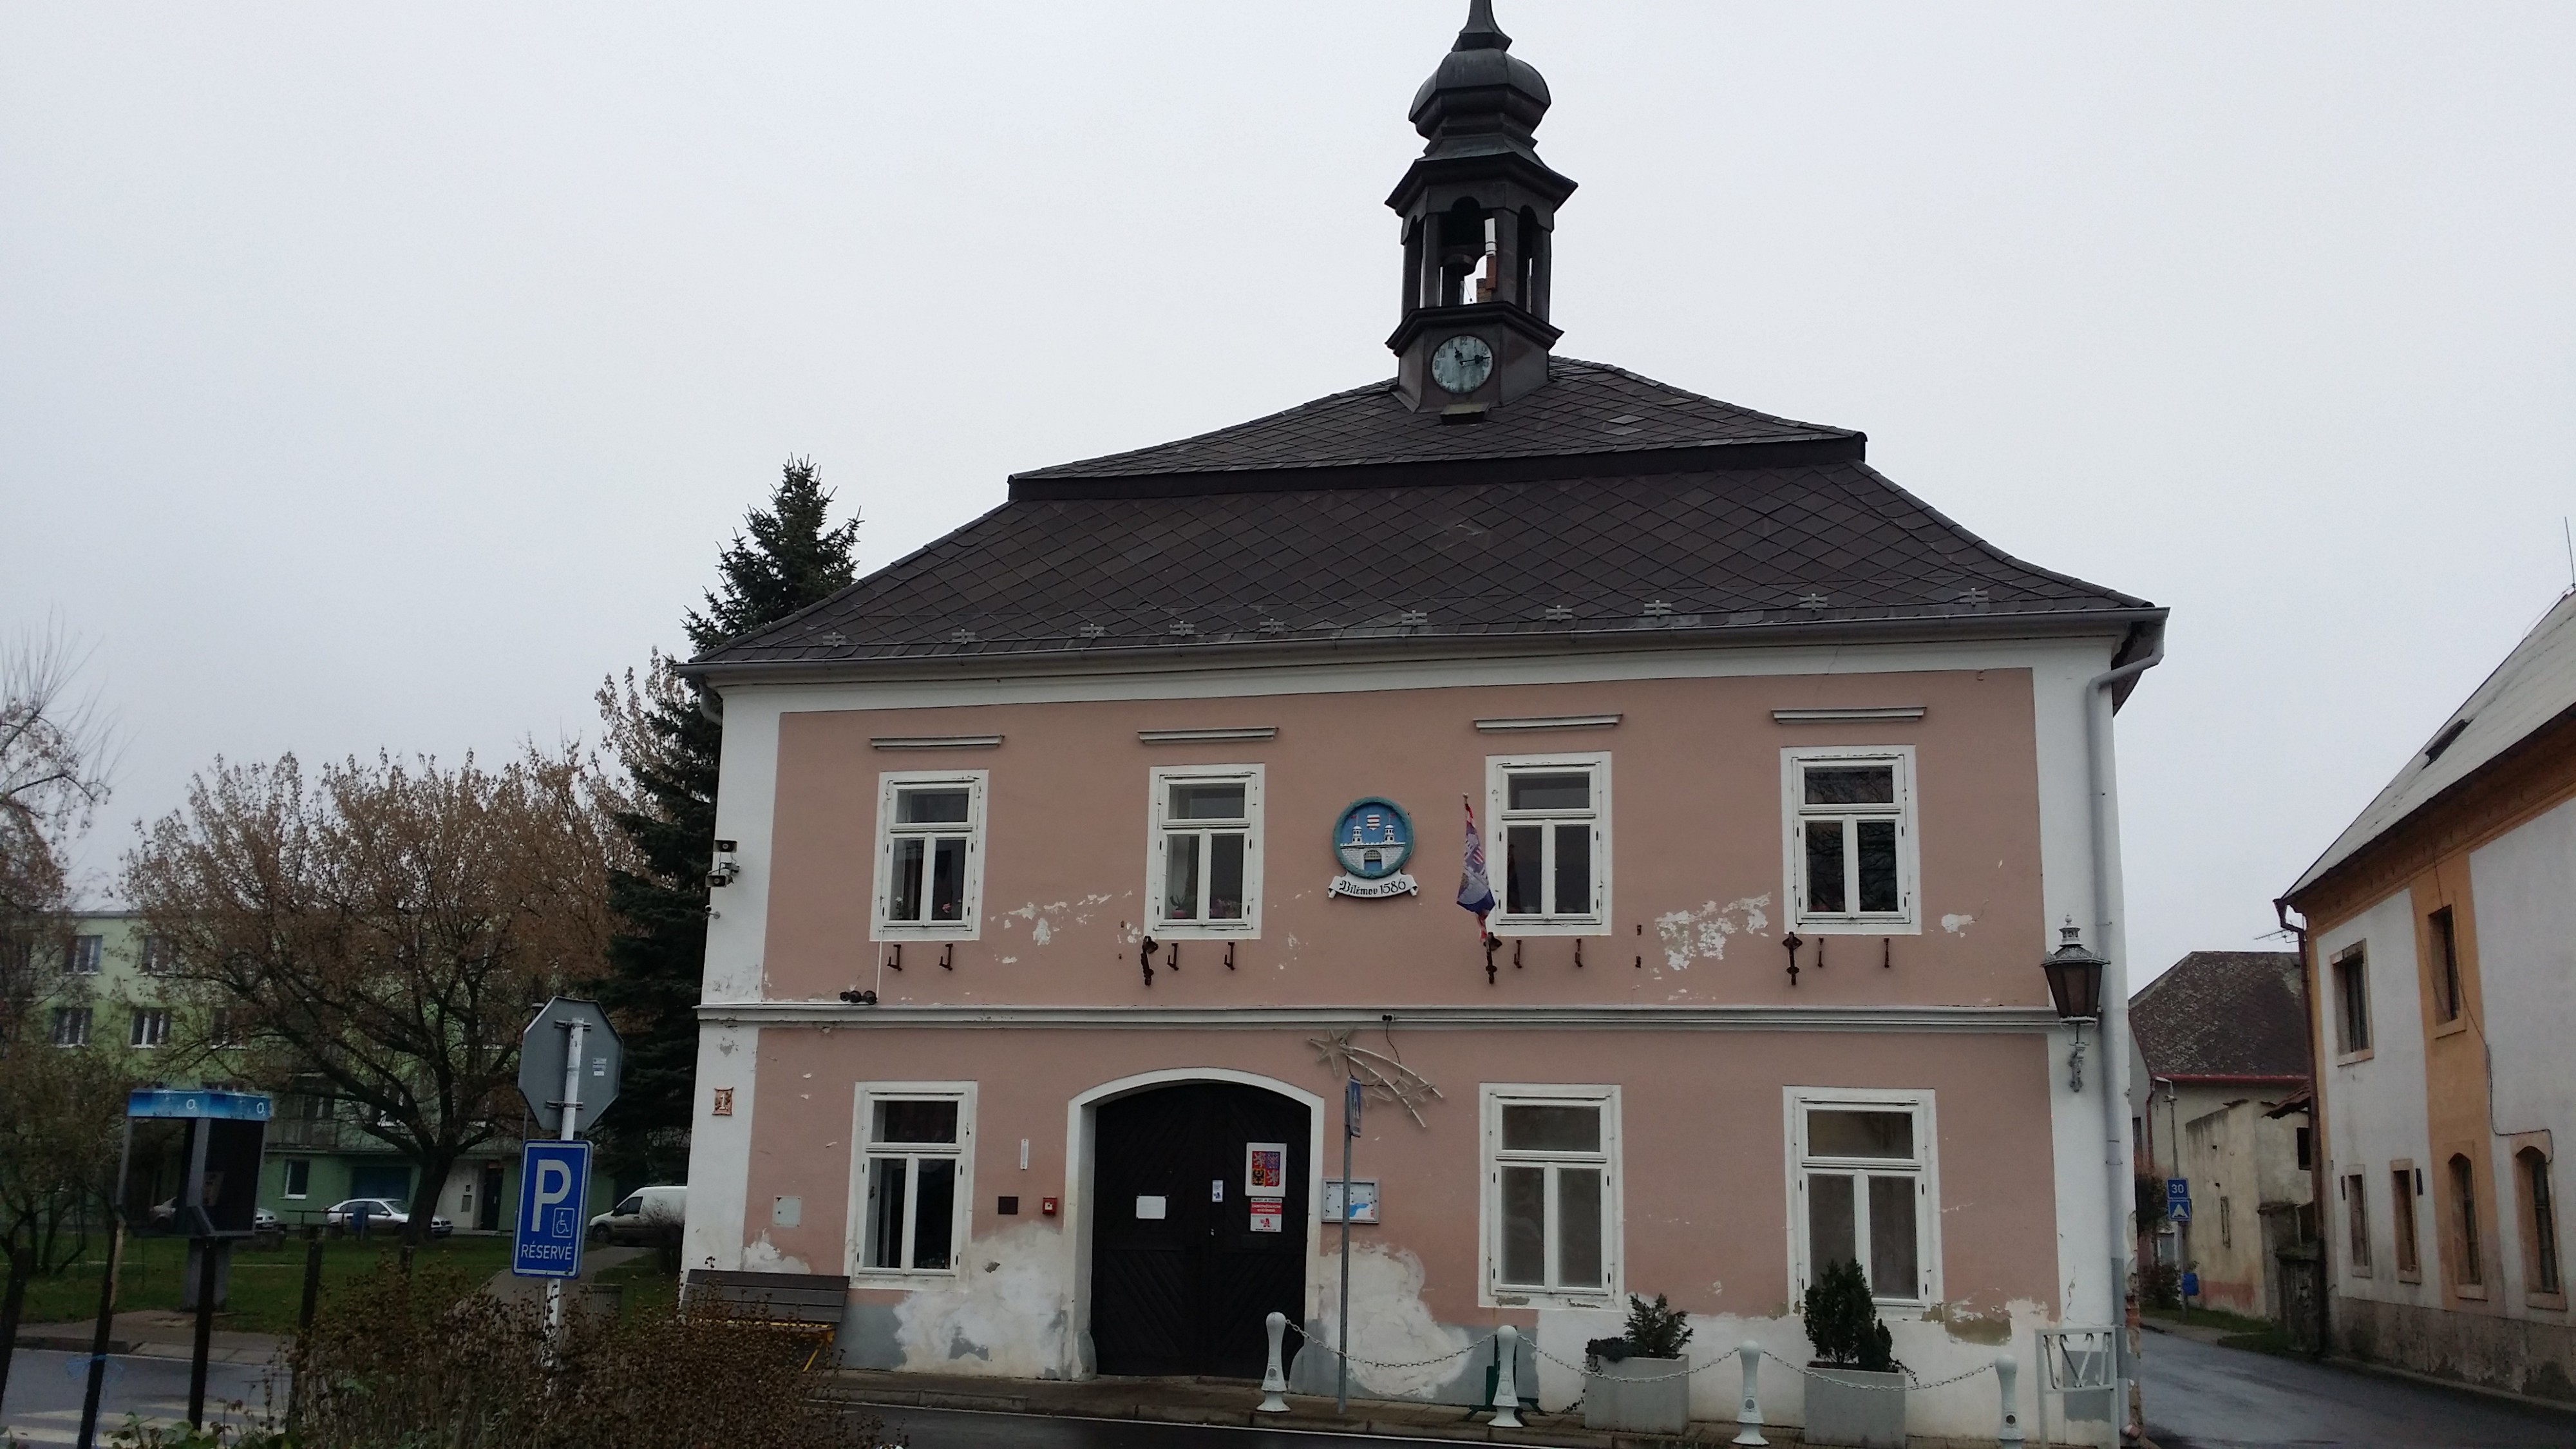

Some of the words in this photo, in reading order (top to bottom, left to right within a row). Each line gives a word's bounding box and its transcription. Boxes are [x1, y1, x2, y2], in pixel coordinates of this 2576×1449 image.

[1379, 878, 1406, 894] 1586
[531, 1159, 572, 1232] P
[2171, 1184, 2184, 1193] 30
[520, 1240, 574, 1260] RÉSERVÉ
